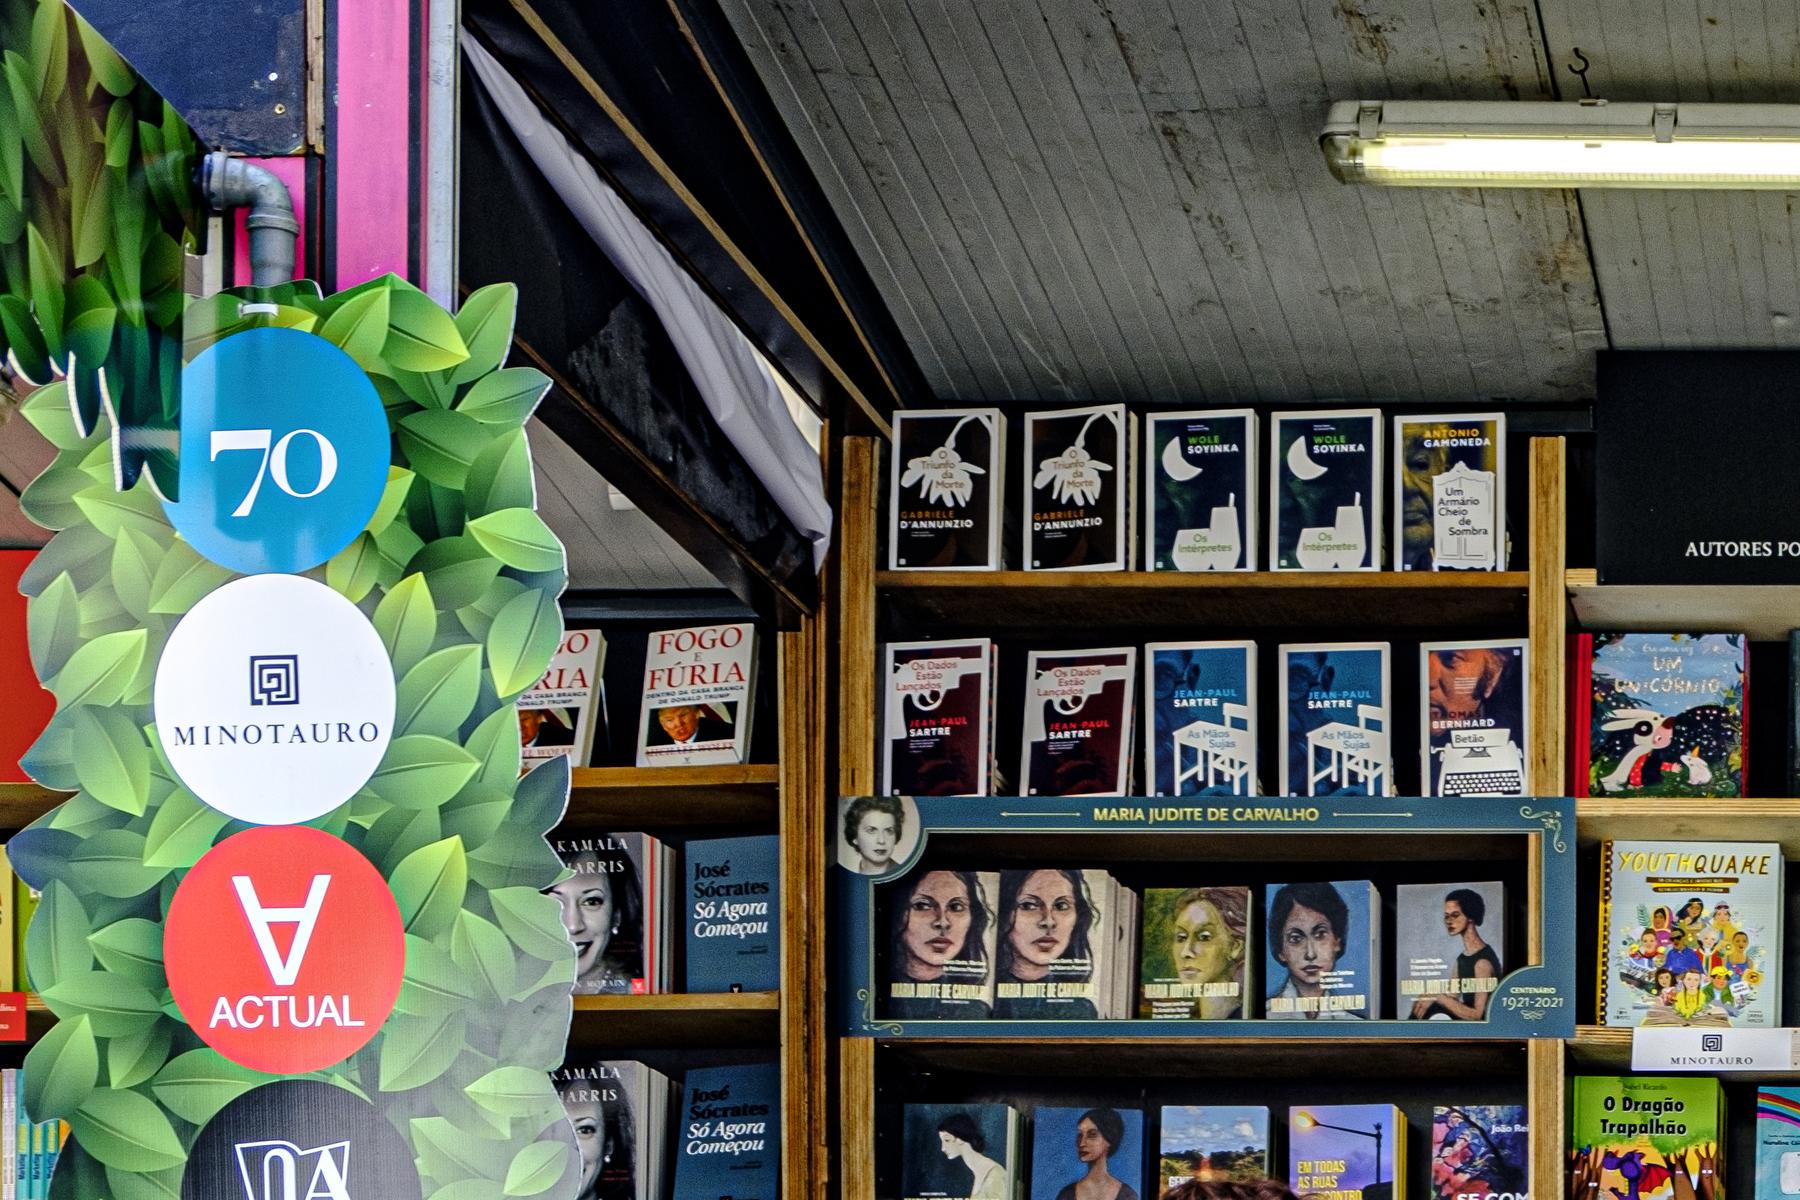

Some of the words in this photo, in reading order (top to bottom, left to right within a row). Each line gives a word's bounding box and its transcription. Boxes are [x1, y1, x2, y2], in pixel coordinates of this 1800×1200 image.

[1313, 434, 1346, 444] WOLE
[1424, 428, 1480, 438] ANTONIO
[1188, 435, 1220, 445] WOLE
[1424, 437, 1491, 449] GAMONEDA
[1187, 443, 1240, 455] SOYINKA
[1313, 442, 1365, 454] SOYINKA
[920, 460, 956, 472] Triunfo
[210, 429, 338, 517] 70
[1445, 487, 1464, 497] Um
[1438, 496, 1480, 507] Armário
[901, 510, 955, 520] GABRIELE
[1033, 509, 1085, 521] GABRIELE
[1438, 507, 1468, 517] Cheio
[1459, 517, 1472, 527] de
[1448, 526, 1488, 537] Sombra
[1685, 541, 1772, 558] AUTORES
[658, 626, 743, 655] FOGO
[927, 660, 957, 671] Dados
[647, 661, 746, 690] FÚRIA
[896, 680, 942, 693] Lançados
[1174, 687, 1238, 698] JEAN-PAUL
[1308, 690, 1372, 700] JEAN-PAUL
[1174, 698, 1219, 708] SARTRE
[1308, 699, 1353, 710] SARTRE
[173, 722, 379, 747] MINOTAURO
[909, 726, 951, 737] SARTRE
[1049, 729, 1092, 740] SARTRE
[1454, 733, 1486, 744] Betão
[1208, 739, 1237, 751] Sujas
[1342, 739, 1371, 752] Sujas
[1094, 808, 1145, 822] MARIA
[1149, 807, 1202, 825] JUDITE
[1207, 808, 1229, 821] DE
[1232, 807, 1320, 822] CARVALHO
[557, 838, 629, 854] KAMALA
[1618, 851, 1771, 875] YOUTHQUAKE
[694, 860, 731, 882] José
[693, 880, 770, 899] Sócrates
[693, 901, 716, 920] Só
[717, 900, 768, 922] Agora
[693, 921, 768, 940] Começou
[1510, 986, 1556, 995] CENTENÁRIO
[1501, 996, 1564, 1009] 1921-2021
[209, 994, 365, 1028] ACTUAL
[1671, 1056, 1754, 1066] MINOTAURO
[691, 1084, 730, 1104] José
[689, 1102, 769, 1121] Sócrates
[1603, 1096, 1616, 1112] O
[1622, 1096, 1685, 1117] Dragão
[687, 1122, 710, 1139] Só
[711, 1121, 766, 1140] Agora
[1491, 1123, 1513, 1134] João
[1600, 1119, 1687, 1138] Trapalhão
[686, 1138, 765, 1157] Começou
[1297, 1161, 1312, 1174] EM
[1314, 1160, 1346, 1173] TODAS
[1312, 1175, 1338, 1188] RUAS
